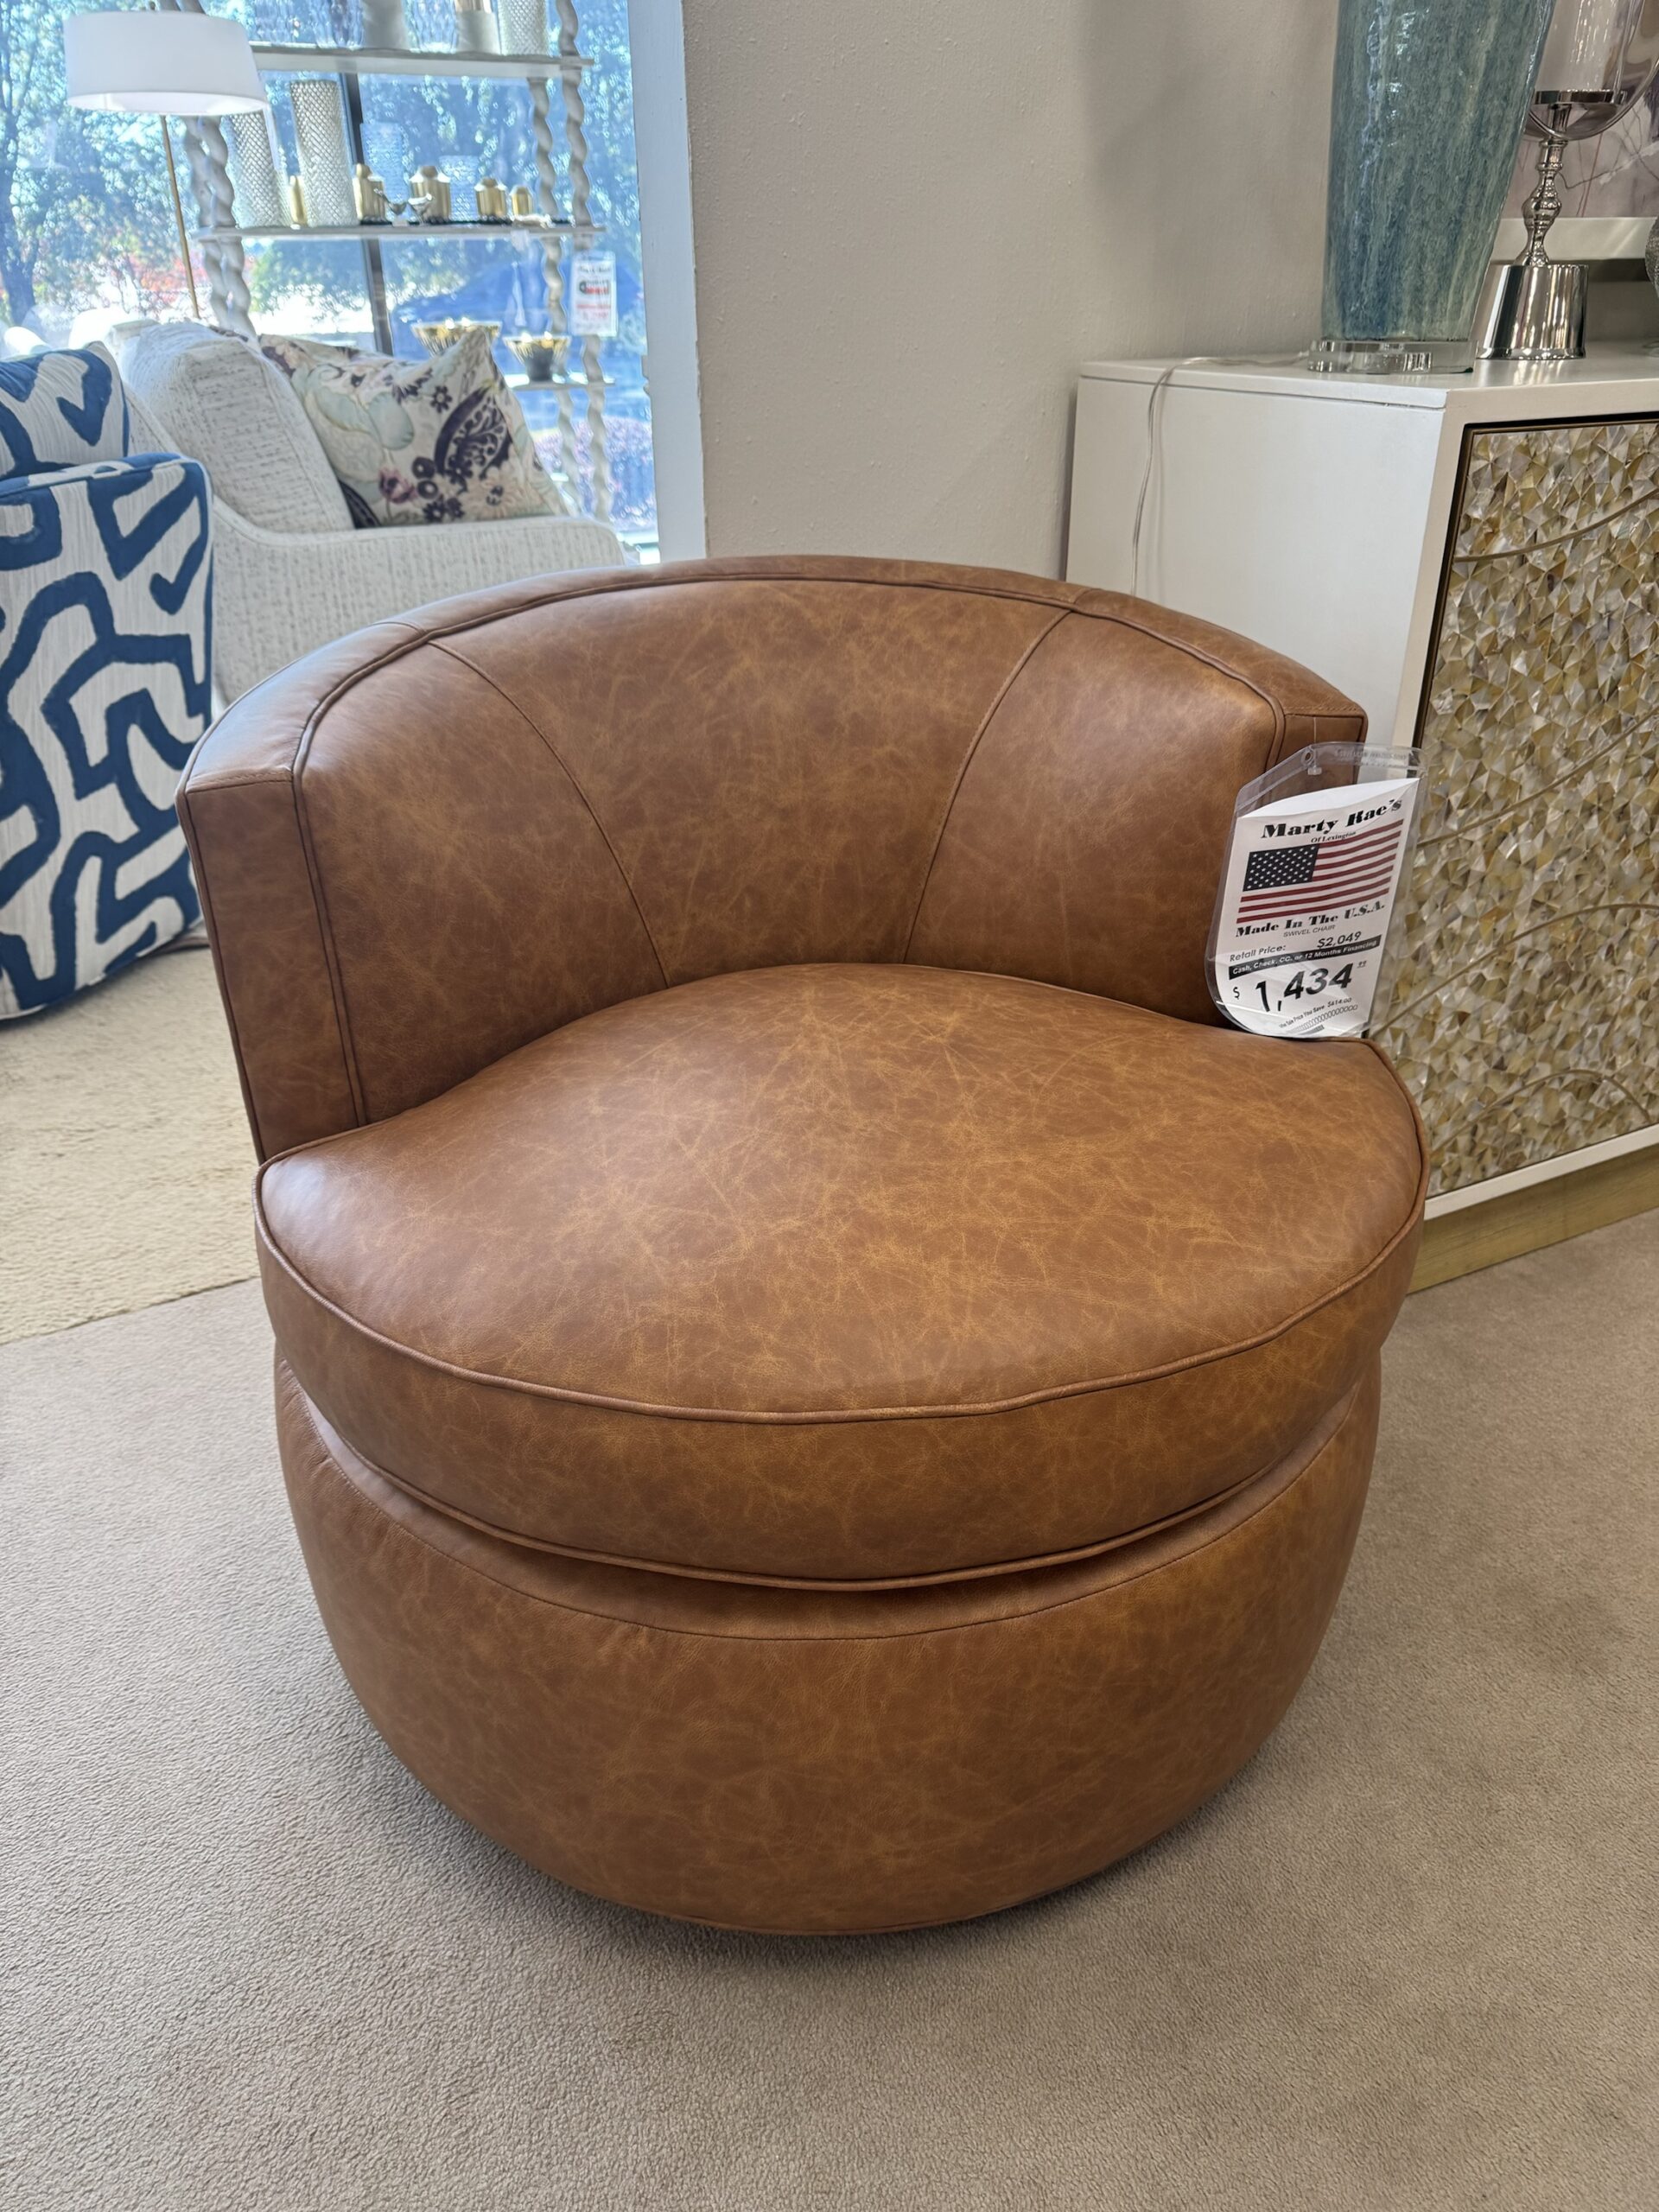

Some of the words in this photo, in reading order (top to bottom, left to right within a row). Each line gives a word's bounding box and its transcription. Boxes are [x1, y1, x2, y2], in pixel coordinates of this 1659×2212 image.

[1261, 820, 1338, 838] Marty
[1345, 798, 1402, 827] Rae's
[1322, 831, 1357, 842] Lexington
[1236, 922, 1279, 938] Made
[1285, 918, 1303, 929] In
[1308, 914, 1338, 926] The
[1344, 900, 1385, 919] U.S.A.
[1283, 929, 1311, 938] SWIVEL
[1313, 925, 1336, 933] CHAIR
[1230, 950, 1256, 962] Retail
[1258, 945, 1287, 957] Price:
[1316, 931, 1362, 949] $2,049
[1313, 948, 1342, 958] Months
[1343, 940, 1377, 954] Financing
[1232, 986, 1241, 1001] $
[1255, 963, 1354, 1013] 1,434
[1303, 1009, 1313, 1018] You
